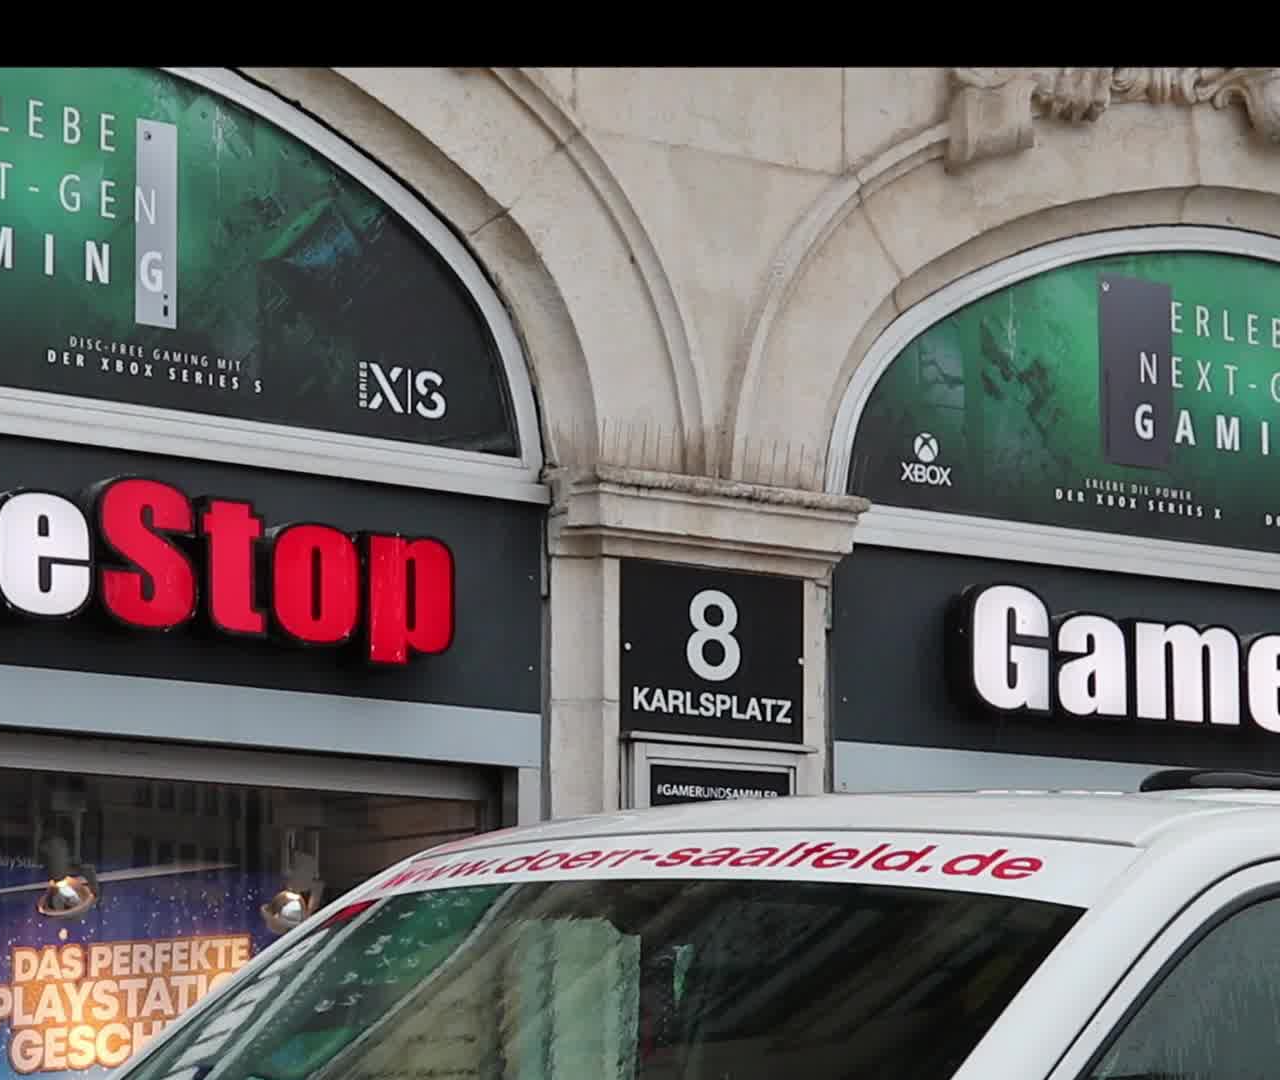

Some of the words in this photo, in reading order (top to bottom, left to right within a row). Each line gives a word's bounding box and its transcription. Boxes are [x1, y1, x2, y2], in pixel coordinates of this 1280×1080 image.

[47, 349, 85, 367] DER
[101, 357, 153, 377] XBOX
[169, 367, 240, 390] SERIES
[254, 380, 263, 393] S
[70, 336, 144, 358] DISC-FREE
[153, 348, 209, 368] GAMING
[217, 358, 241, 372] MIT
[901, 462, 952, 487] XBOX
[1156, 487, 1192, 500] POWER
[1055, 488, 1084, 502] DER
[1096, 493, 1136, 509] XBOX
[1148, 500, 1203, 517] SERIES
[686, 589, 741, 681] 8
[632, 686, 792, 724] KARLSPLATZ
[380, 841, 1043, 890] www.doerr-saalfeld.de
[15, 945, 83, 981] DAS
[90, 936, 250, 976] PERFEKTE
